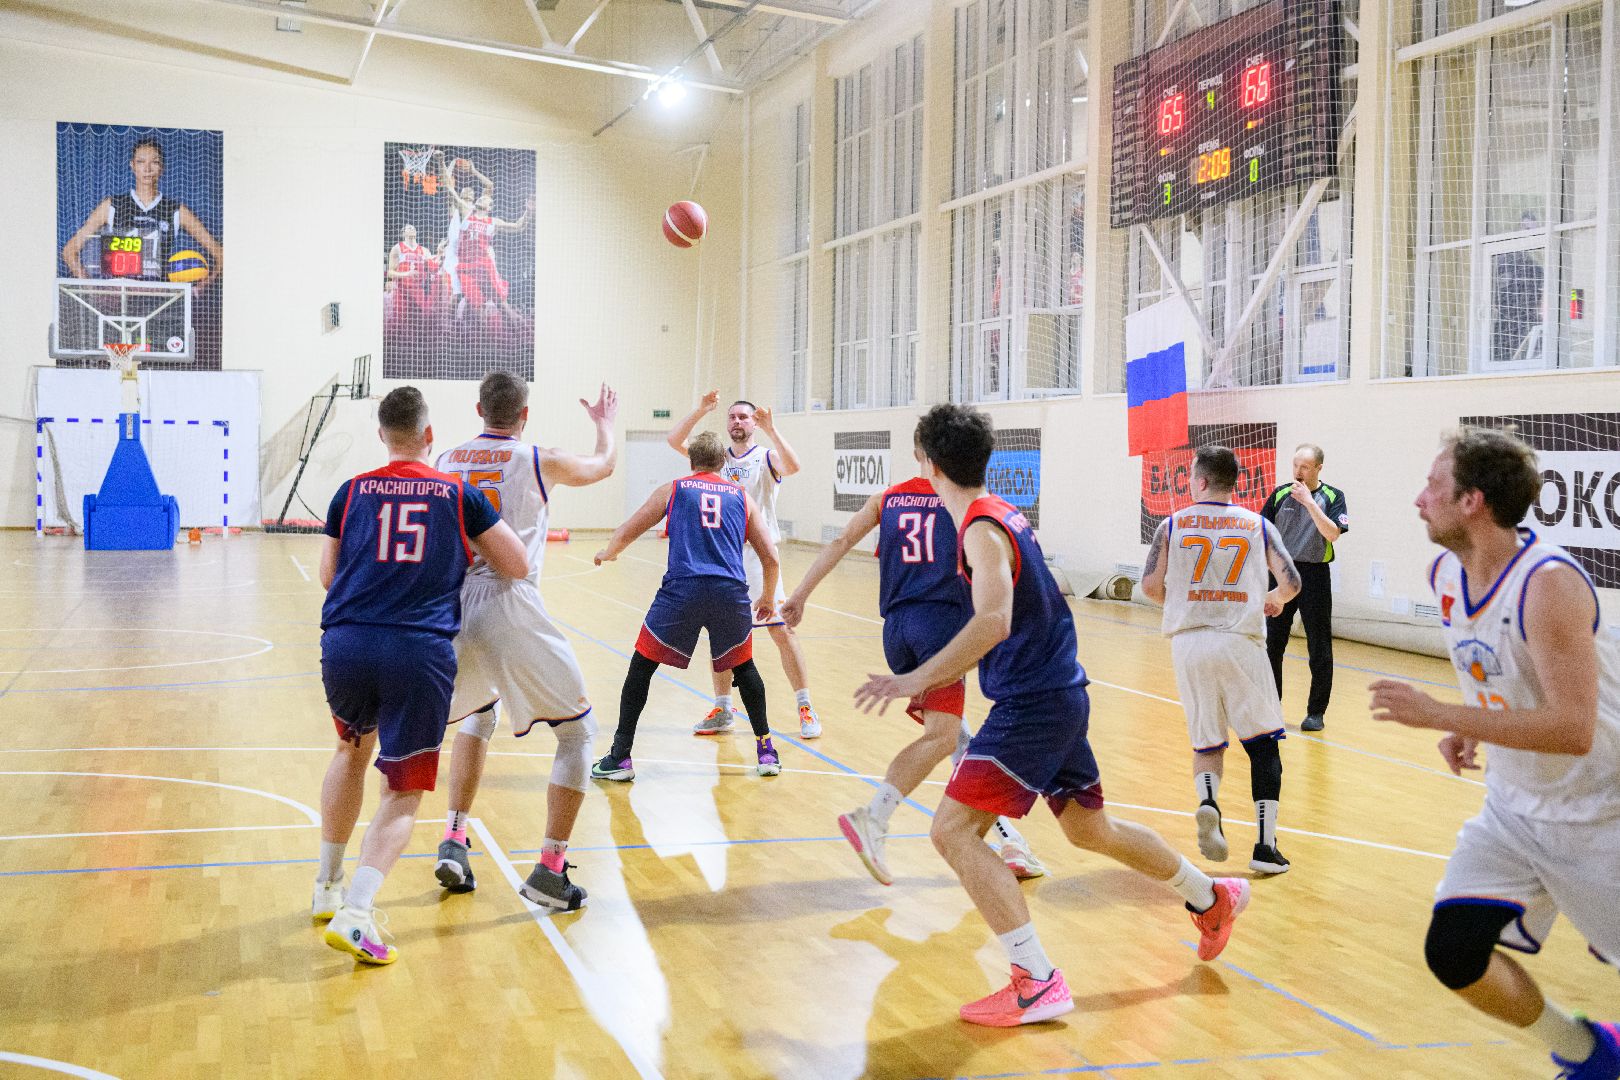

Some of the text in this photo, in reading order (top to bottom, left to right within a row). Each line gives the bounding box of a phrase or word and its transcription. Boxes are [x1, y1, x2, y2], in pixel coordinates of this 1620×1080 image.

[1206, 90, 1215, 110] 4
[1244, 64, 1268, 107] 66
[1161, 95, 1182, 133] 65
[1197, 147, 1231, 184] 2:09
[1249, 157, 1259, 182] 0
[1163, 182, 1171, 205] 3
[110, 237, 142, 253] 2:09
[114, 252, 139, 275] 07
[837, 455, 884, 485] ФУТБОЛ
[1151, 465, 1265, 498] БАСОЛ
[360, 479, 450, 499] КРАСНОГОРСК
[449, 469, 505, 513] 5
[680, 480, 739, 496] КРАСНОГОРСК
[887, 496, 945, 508] КРАСНОГОРС
[701, 493, 721, 528] 9
[1177, 515, 1256, 531] МЕЛЬНИКОВ
[376, 501, 429, 563] 15
[898, 511, 936, 563] 31
[1180, 534, 1250, 585] 77
